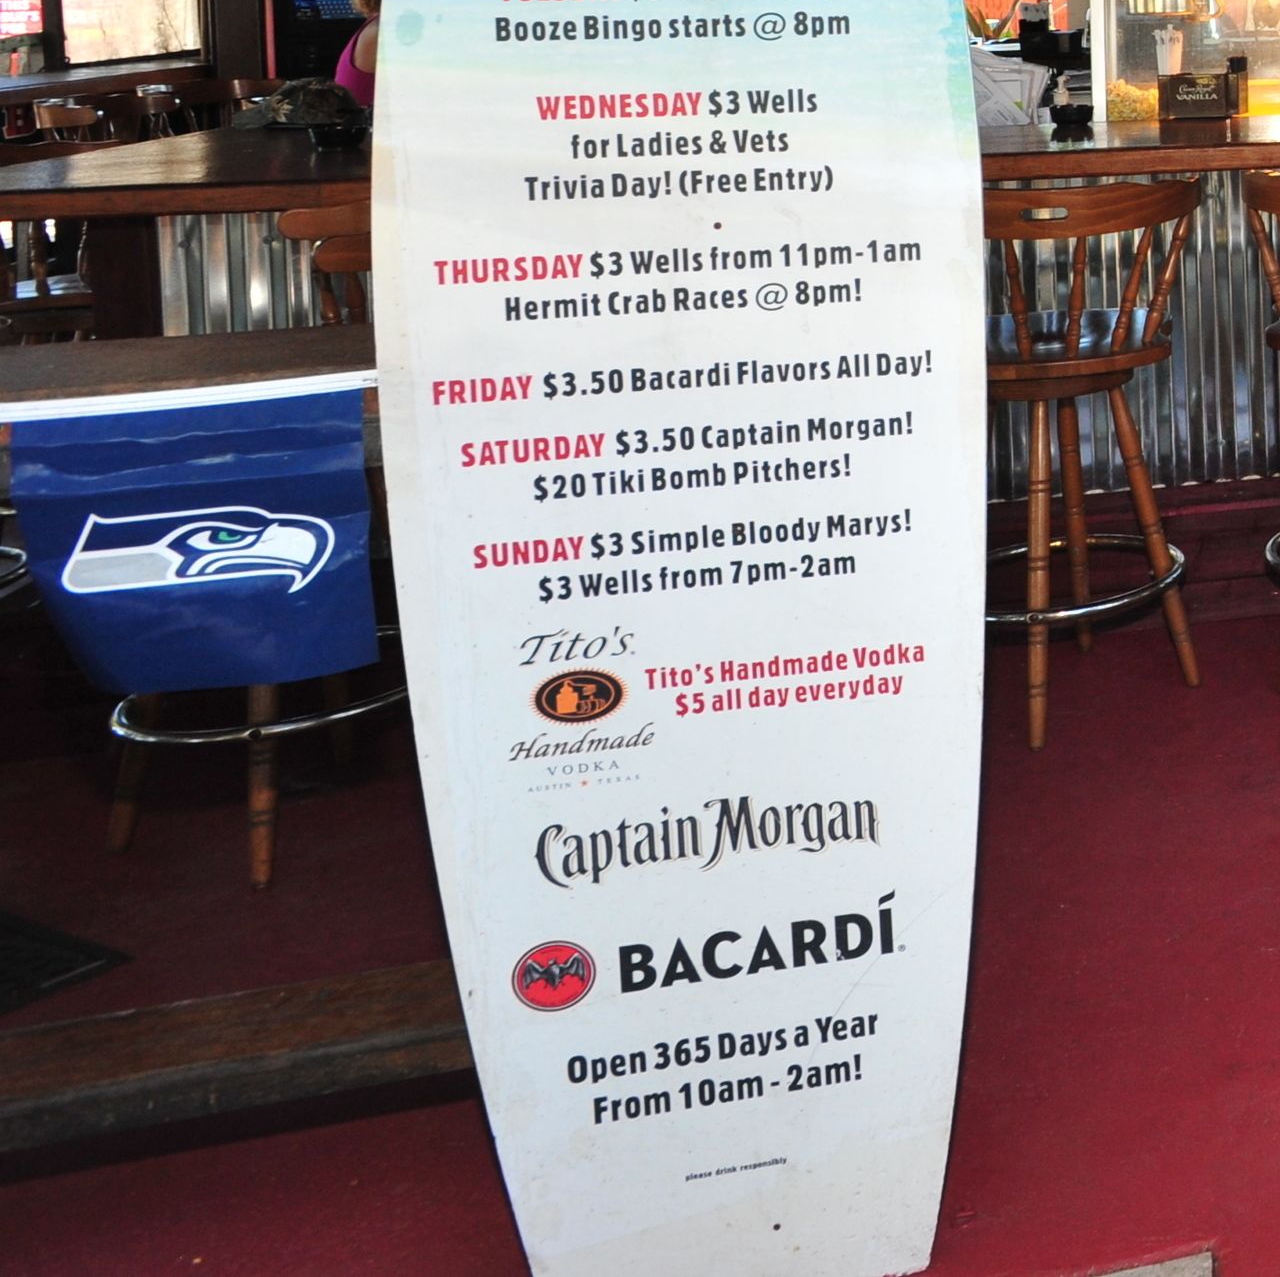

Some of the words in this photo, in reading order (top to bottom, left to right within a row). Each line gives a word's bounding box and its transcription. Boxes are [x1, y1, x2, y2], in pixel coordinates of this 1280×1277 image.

[495, 17, 577, 41] Booze
[583, 15, 663, 41] Bingo
[669, 14, 746, 39] starts
[753, 12, 787, 41] @
[793, 12, 850, 38] 8pm
[537, 91, 702, 120] WEDNESDAY
[708, 90, 740, 117] $3
[748, 88, 818, 115] Wells
[1176, 93, 1218, 101] VANILLA
[524, 175, 604, 201] Trivia
[611, 170, 671, 200] Day!
[679, 169, 748, 197] (Free
[754, 164, 834, 194] Entry)
[434, 254, 583, 285] THURSDAY
[590, 251, 623, 280] $3
[630, 250, 703, 275] Wells
[710, 245, 772, 271] from
[778, 241, 921, 268] 11pm-1am
[504, 292, 600, 322] Hermit
[607, 288, 666, 315] Crab
[673, 287, 748, 312] Races
[755, 282, 788, 312] @
[795, 278, 862, 307] 8pm!
[433, 374, 532, 406] FRIDAY
[543, 369, 625, 400] $3.50
[631, 361, 731, 393] Bacardi
[737, 353, 830, 386] Flavors
[837, 355, 870, 379] All
[876, 350, 932, 377] Day!
[461, 432, 605, 468] SATURDAY
[615, 426, 695, 457] $3.50
[701, 420, 800, 450] Captain
[807, 411, 913, 444] Morgan!
[534, 473, 586, 503] $20
[592, 470, 645, 497] Tiki
[652, 462, 726, 490] Bomb
[733, 453, 851, 485] Pitchers!
[473, 536, 583, 569] SUNDAY
[590, 533, 624, 560] $3
[631, 527, 725, 558] Simple
[731, 518, 821, 547] Bloody
[826, 508, 912, 539] Marys!
[519, 625, 634, 667] Tito's
[645, 663, 714, 691] Tito's
[719, 650, 848, 684] Handmade
[853, 642, 925, 669] Vodka
[508, 722, 655, 762] Handmade
[527, 781, 573, 794] AUSTIN
[597, 774, 641, 786] TEXAS
[547, 759, 621, 777] VODKA
[535, 806, 701, 890] Captain
[700, 795, 880, 873] Morgan
[618, 888, 896, 994] BACARDÍ
[567, 1049, 647, 1085] Open
[653, 1034, 711, 1070] 365
[718, 1028, 787, 1061] Days
[794, 1023, 809, 1047] a
[815, 1012, 877, 1044] Year
[593, 1083, 672, 1125] From
[678, 1075, 764, 1112] 10am
[786, 1053, 862, 1093] 2am!
[685, 1170, 713, 1182] please
[715, 1165, 738, 1176] drink
[739, 1156, 788, 1173] responsibly
